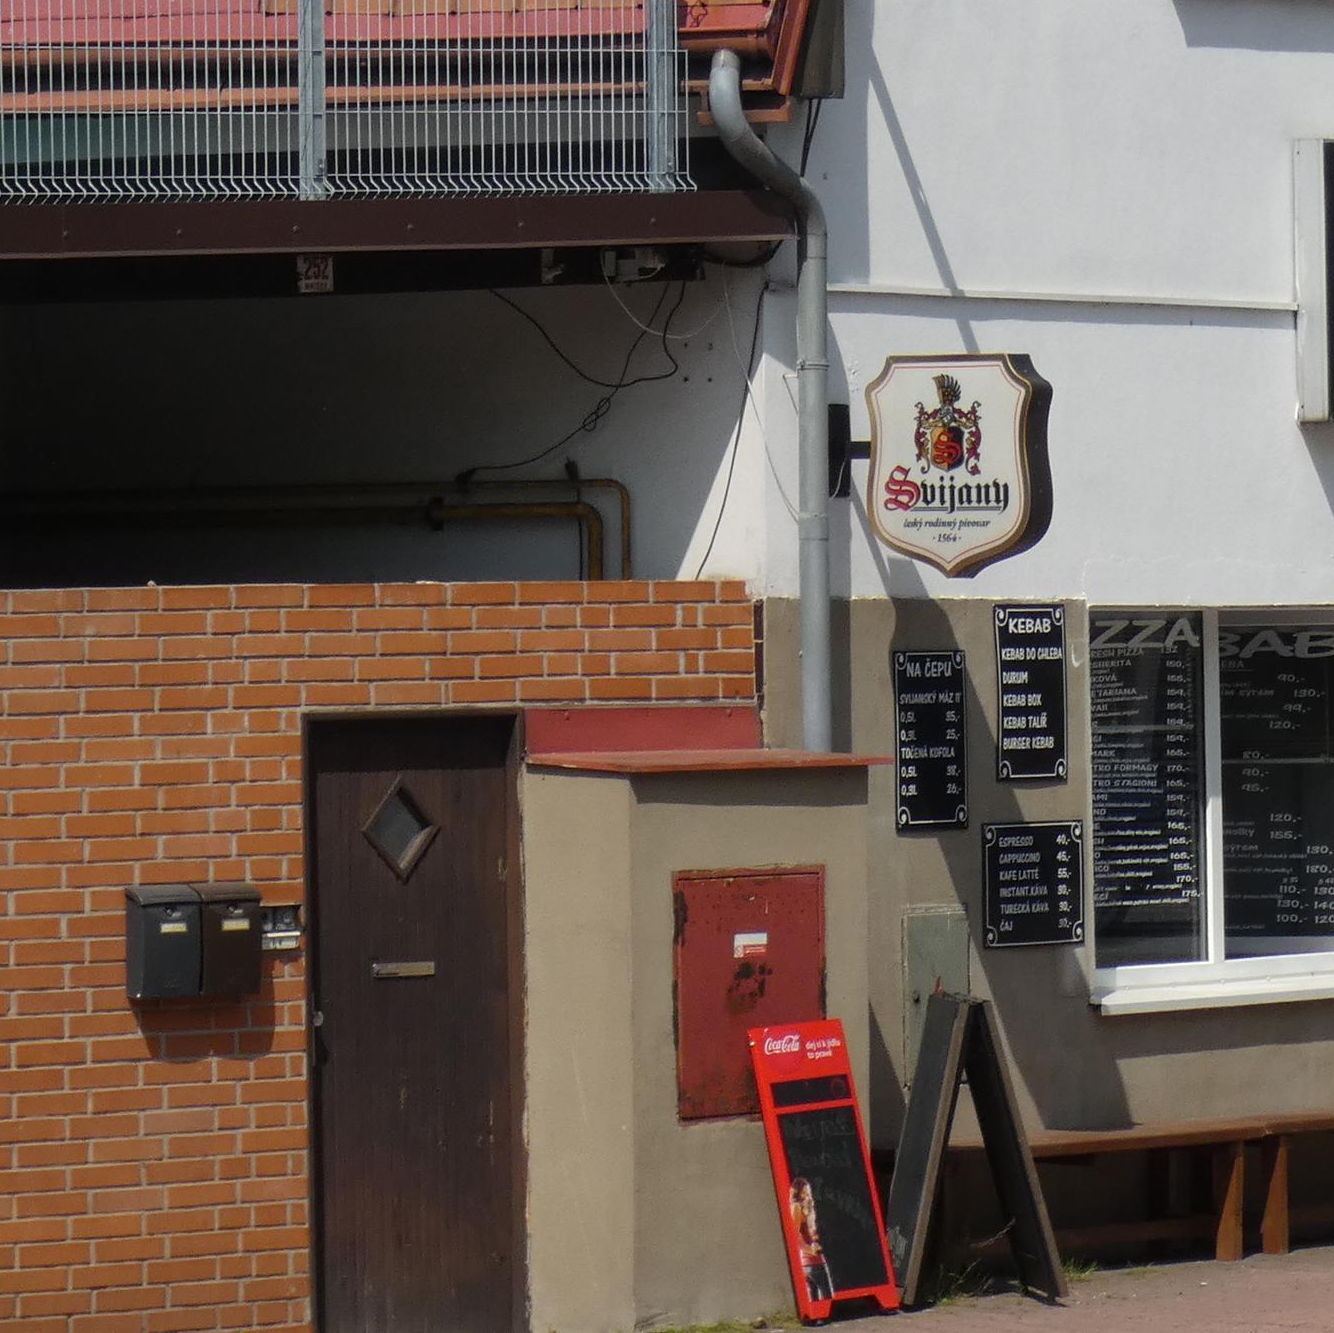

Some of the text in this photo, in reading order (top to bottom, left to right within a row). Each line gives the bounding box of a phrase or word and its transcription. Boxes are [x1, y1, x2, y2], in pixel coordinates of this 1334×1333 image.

[884, 465, 1010, 516] Svijany
[1008, 618, 1052, 634] KEBAB
[1001, 647, 1025, 661] KEBAB
[1026, 647, 1036, 660] DO
[907, 658, 952, 677] NA ČEPU
[1003, 693, 1042, 707] KEBAB BOX
[1003, 716, 1027, 729] KEBAB
[1032, 736, 1055, 749] KEBAB
[999, 836, 1034, 848] ESPRESSO
